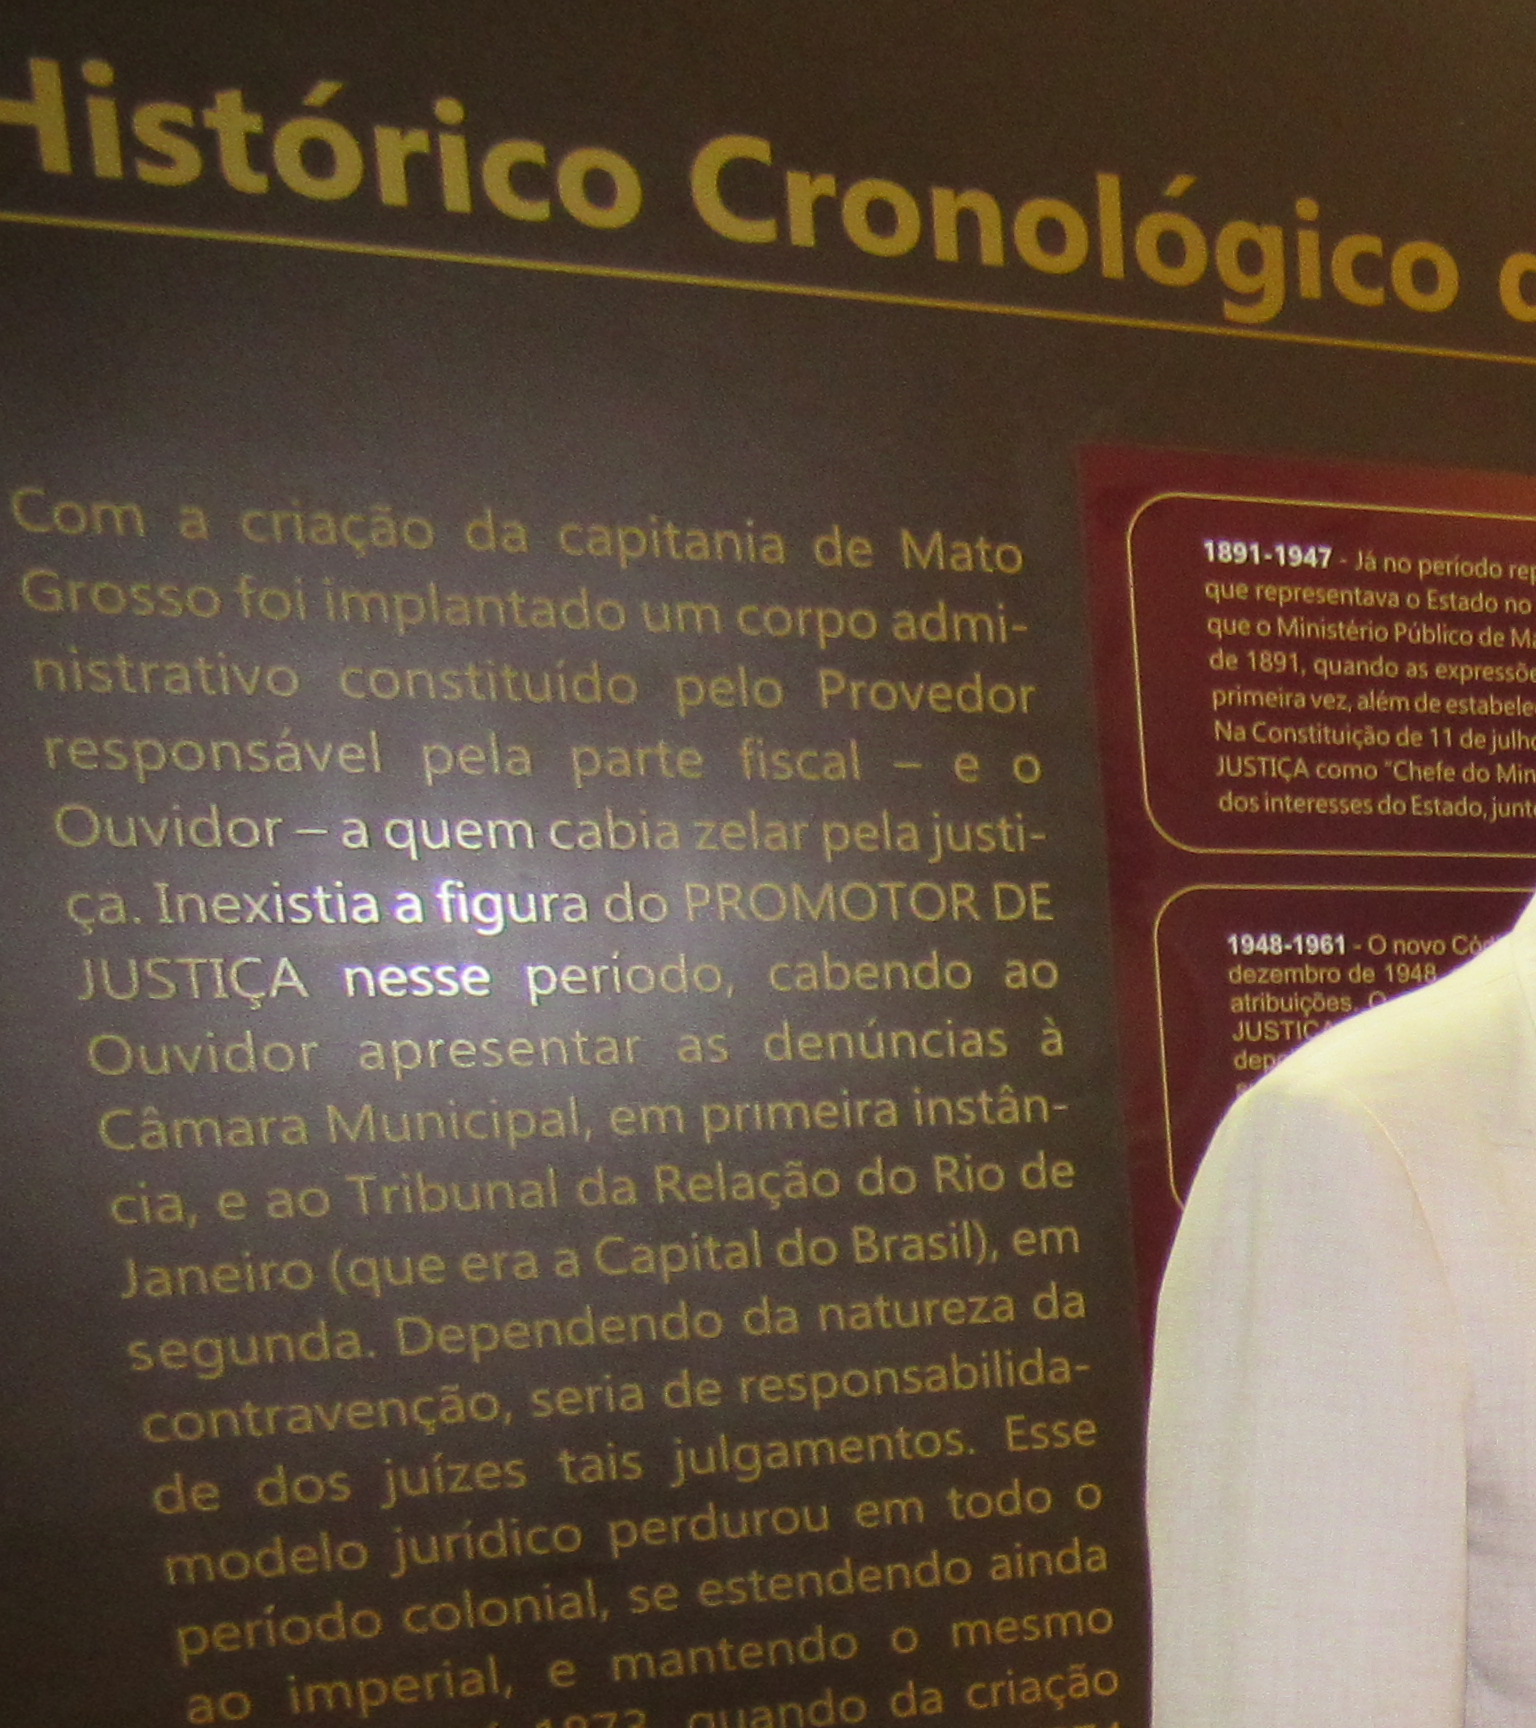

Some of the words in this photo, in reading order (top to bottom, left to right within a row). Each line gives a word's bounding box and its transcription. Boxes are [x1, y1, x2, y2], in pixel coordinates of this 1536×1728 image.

[691, 134, 1459, 325] Cronológico
[12, 486, 145, 537] Com
[180, 505, 208, 540] a
[241, 504, 434, 557] criação
[465, 508, 528, 553] da
[559, 518, 786, 569] capitania
[814, 524, 873, 568] de
[901, 528, 1024, 575] Mato
[1204, 540, 1333, 569] 1891-1947
[1354, 549, 1378, 572] Já
[1384, 556, 1413, 574] no
[1418, 557, 1503, 580] período
[1204, 581, 1249, 604] que
[1255, 584, 1399, 608] representava
[1406, 593, 1420, 609] o
[1427, 589, 1498, 613] Estado
[1505, 598, 1532, 614] no
[1207, 617, 1251, 639] que
[1256, 620, 1271, 637] o
[1277, 616, 1388, 643] Ministério
[1394, 621, 1473, 646] Público
[1478, 626, 1505, 647] de
[33, 653, 299, 698] nistrativo
[339, 661, 638, 705] constituído
[675, 665, 783, 718] pelo
[819, 668, 1037, 714] Provedor
[1209, 648, 1238, 670] de
[1248, 650, 1305, 676] 1891,
[1313, 656, 1399, 679] quando
[1406, 661, 1428, 679] as
[1212, 689, 1306, 712] primeira
[1310, 694, 1352, 713] vez,
[1358, 691, 1411, 712] além
[1414, 692, 1442, 714] de
[1214, 720, 1247, 742] Na
[1252, 720, 1391, 751] Constituição
[1395, 729, 1424, 748] de
[1430, 727, 1452, 748] 11
[1460, 728, 1487, 751] de
[1215, 755, 1310, 783] JUSTIÇA
[1316, 762, 1379, 781] como
[1462, 763, 1491, 784] do
[1218, 791, 1260, 813] dos
[1264, 795, 1373, 815] interesses
[1377, 794, 1406, 815] do
[1411, 794, 1487, 819] Estado,
[67, 892, 146, 934] ça.
[155, 880, 379, 925] Inexistia
[396, 892, 423, 924] a
[436, 879, 587, 937] figura
[604, 881, 668, 923] do
[685, 882, 980, 922] PROMOTOR
[993, 882, 1054, 922] DE
[1228, 934, 1345, 955] 1948-1961
[1367, 933, 1387, 956] O
[1393, 937, 1447, 956] novo
[79, 957, 308, 1010] JUSTIÇA
[345, 965, 490, 997] nesse
[527, 953, 733, 1007] período,
[769, 950, 972, 992] cabendo
[1004, 960, 1059, 990] ao
[1228, 965, 1341, 983] dezembro
[1348, 964, 1375, 983] de
[99, 1105, 308, 1152] Câmara
[327, 1096, 591, 1149] Municipal,
[610, 1104, 684, 1137] em
[702, 1098, 898, 1144] primeira
[914, 1084, 1068, 1126] instân-
[127, 1320, 376, 1381] segunda.
[395, 1301, 723, 1363] Dependendo
[743, 1295, 799, 1336] da
[819, 1294, 1015, 1332] natureza
[1033, 1281, 1086, 1321] da
[142, 1384, 512, 1444] contravenção,
[531, 1382, 645, 1418] seria
[663, 1368, 722, 1409] de
[740, 1347, 1091, 1410] responsabilida-
[165, 1532, 369, 1585] modelo
[391, 1518, 583, 1579] jurídico
[609, 1502, 830, 1559] perdurou
[855, 1496, 925, 1529] em
[947, 1478, 1053, 1520] todo
[1075, 1481, 1103, 1511] o
[890, 1680, 944, 1719] da
[966, 1663, 1120, 1710] criação
